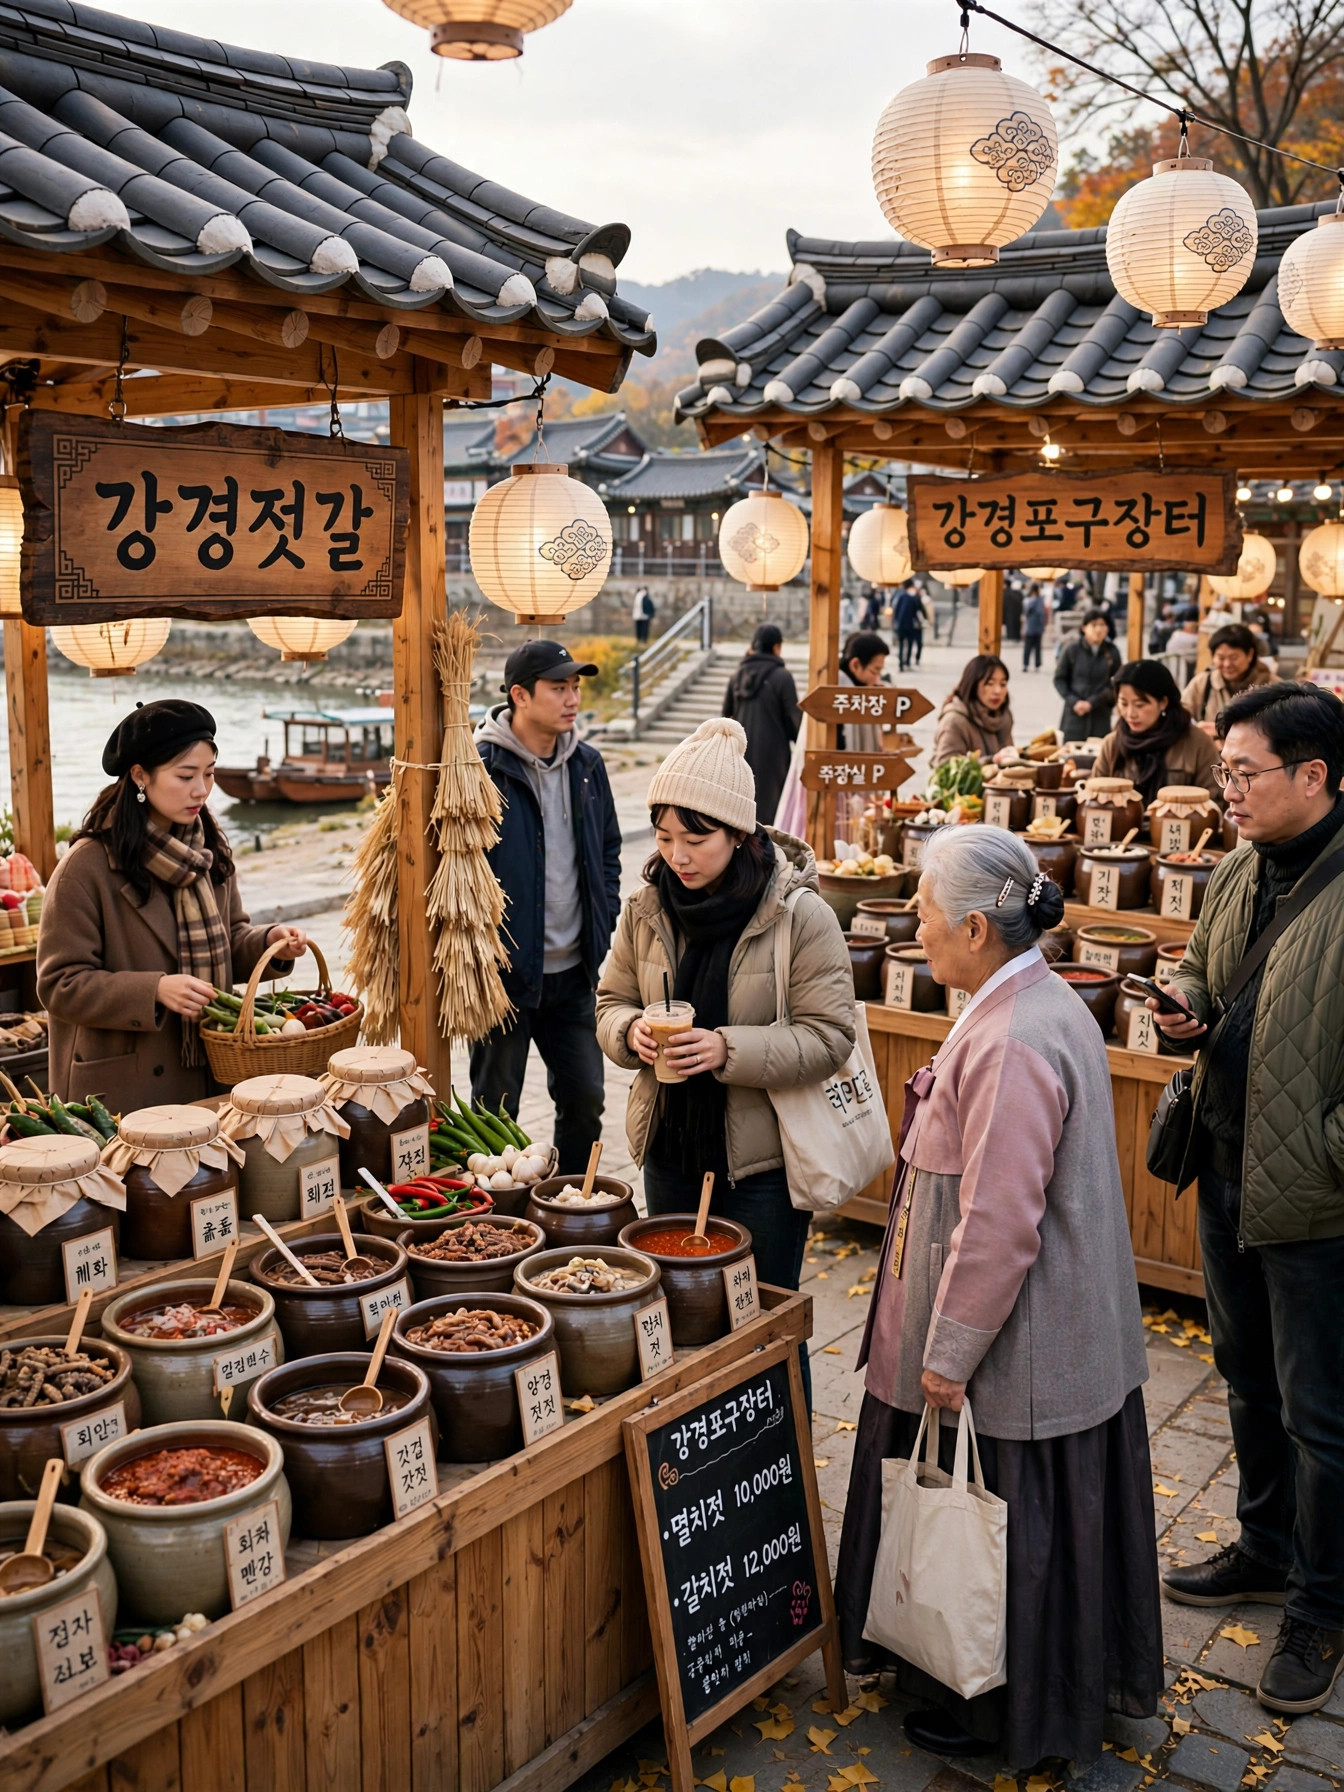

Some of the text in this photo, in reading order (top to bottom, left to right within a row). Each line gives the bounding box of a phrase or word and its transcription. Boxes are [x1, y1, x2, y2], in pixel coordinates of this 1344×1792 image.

[95, 470, 374, 572] 강경젓갈
[932, 492, 1206, 549] 강경포구장터
[832, 694, 912, 718] 주차장 P
[872, 765, 885, 784] P
[670, 1379, 774, 1460] 강경포구장터
[670, 1453, 793, 1548] 멸치젓 10,000원
[681, 1555, 735, 1615] 갈치젓
[743, 1522, 802, 1578] 12,000원
